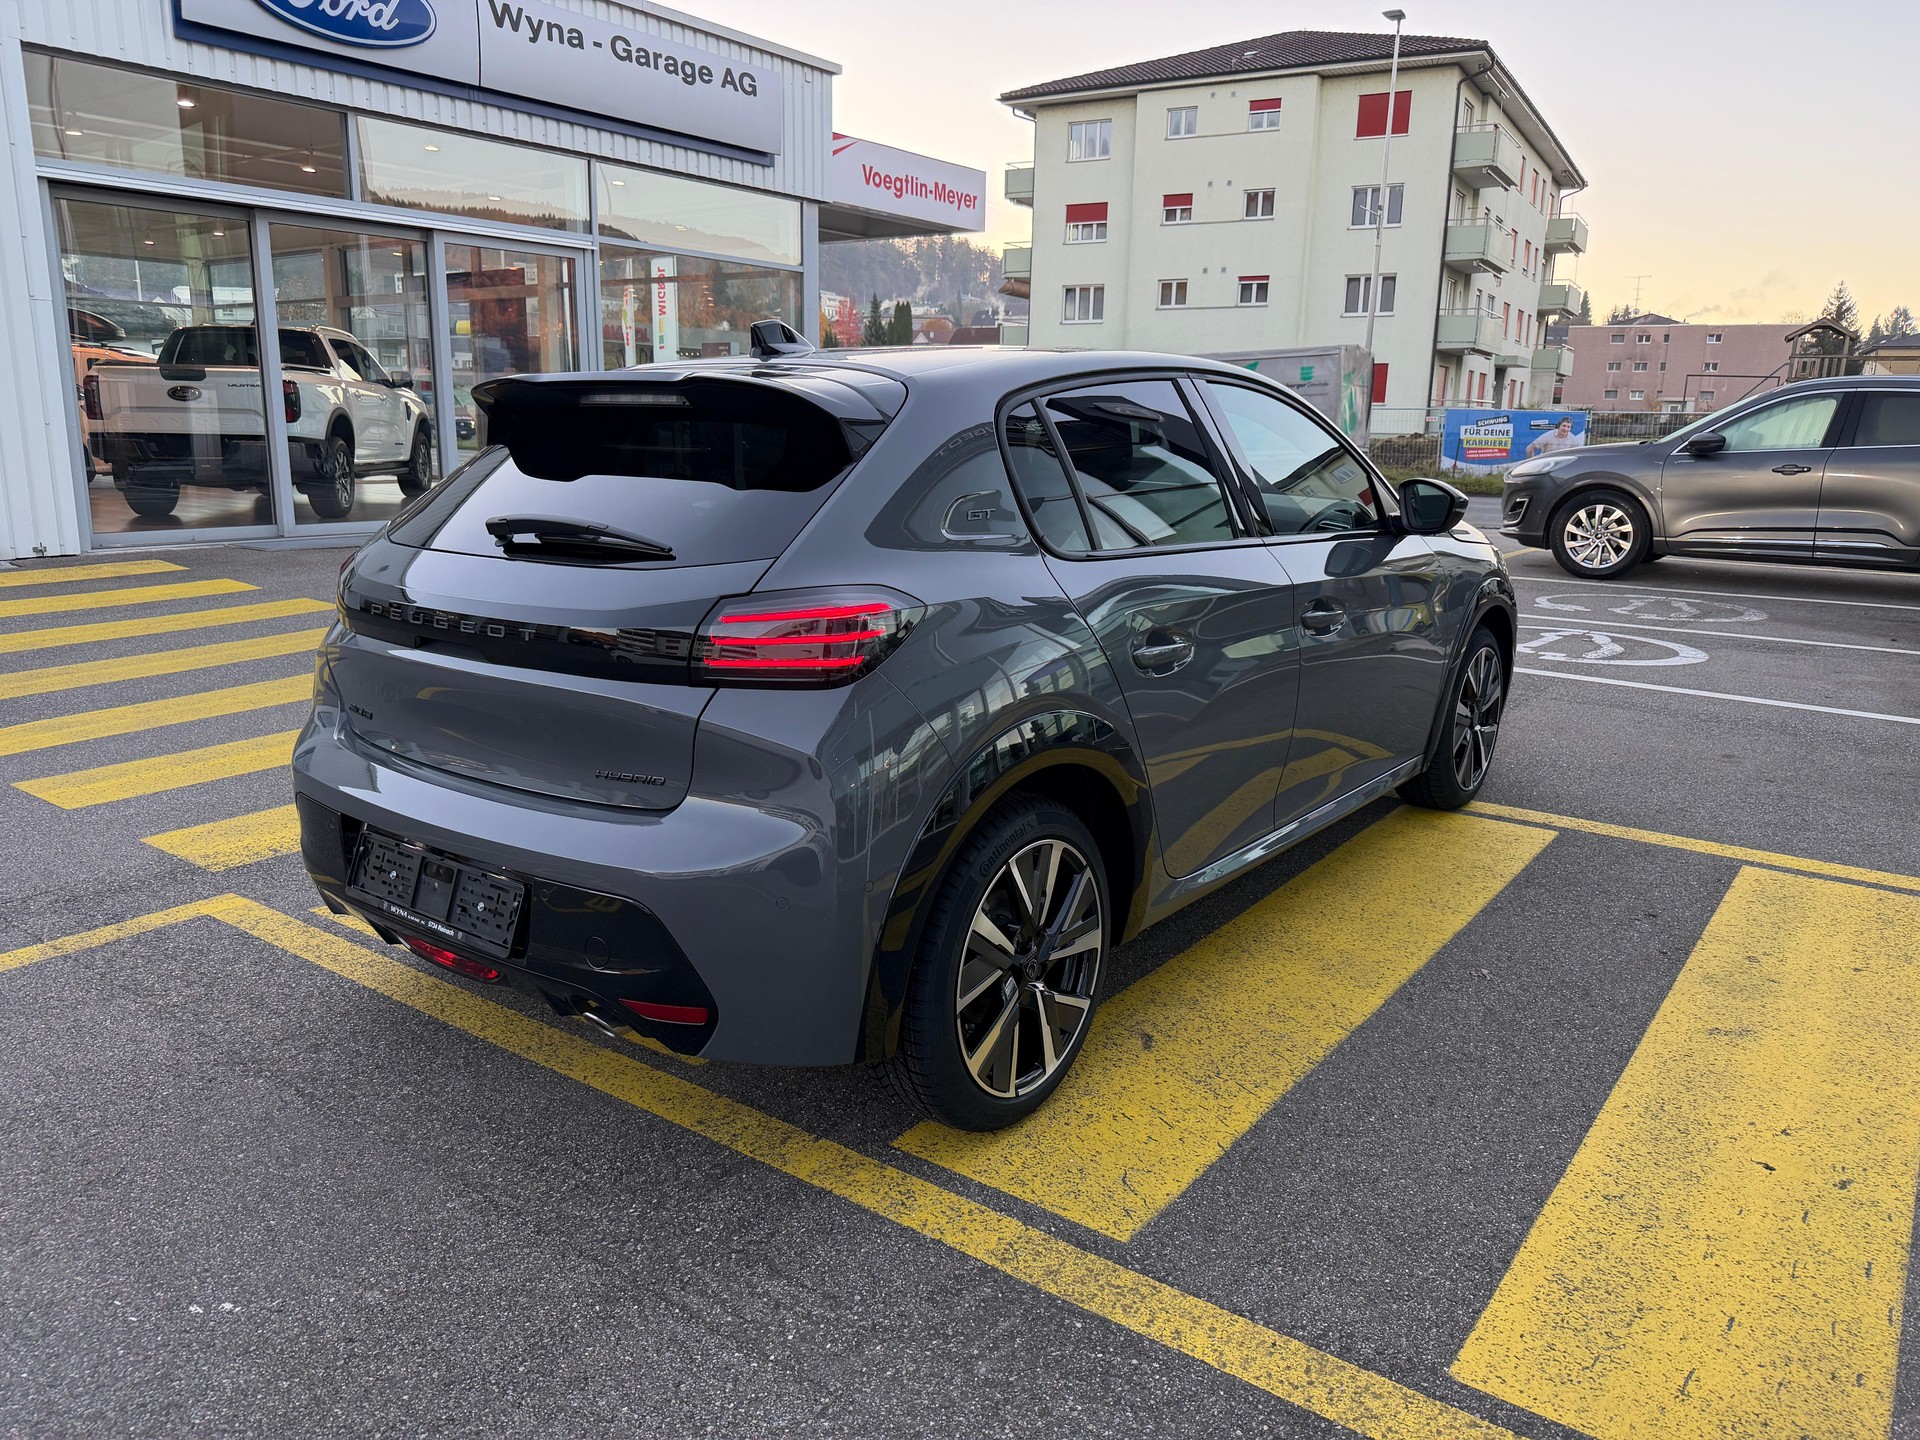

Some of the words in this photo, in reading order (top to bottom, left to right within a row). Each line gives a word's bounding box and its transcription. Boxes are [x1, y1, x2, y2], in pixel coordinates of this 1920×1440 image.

[487, 0, 585, 50] Wyna
[610, 35, 714, 86] Garage
[720, 67, 758, 97] AG
[861, 163, 978, 211] Voegtlin-Meyer
[1464, 426, 1481, 436] FÜR
[1483, 428, 1511, 437] DEINE
[1477, 416, 1508, 427] SCHWUNG
[1465, 438, 1509, 447] KARRIERE
[966, 508, 997, 521] GT
[370, 603, 537, 643] PEUGEOT
[595, 769, 666, 786] HYBRID
[978, 822, 1030, 879] Continental
[390, 905, 409, 918] WYNA
[437, 924, 455, 937] Reinach
